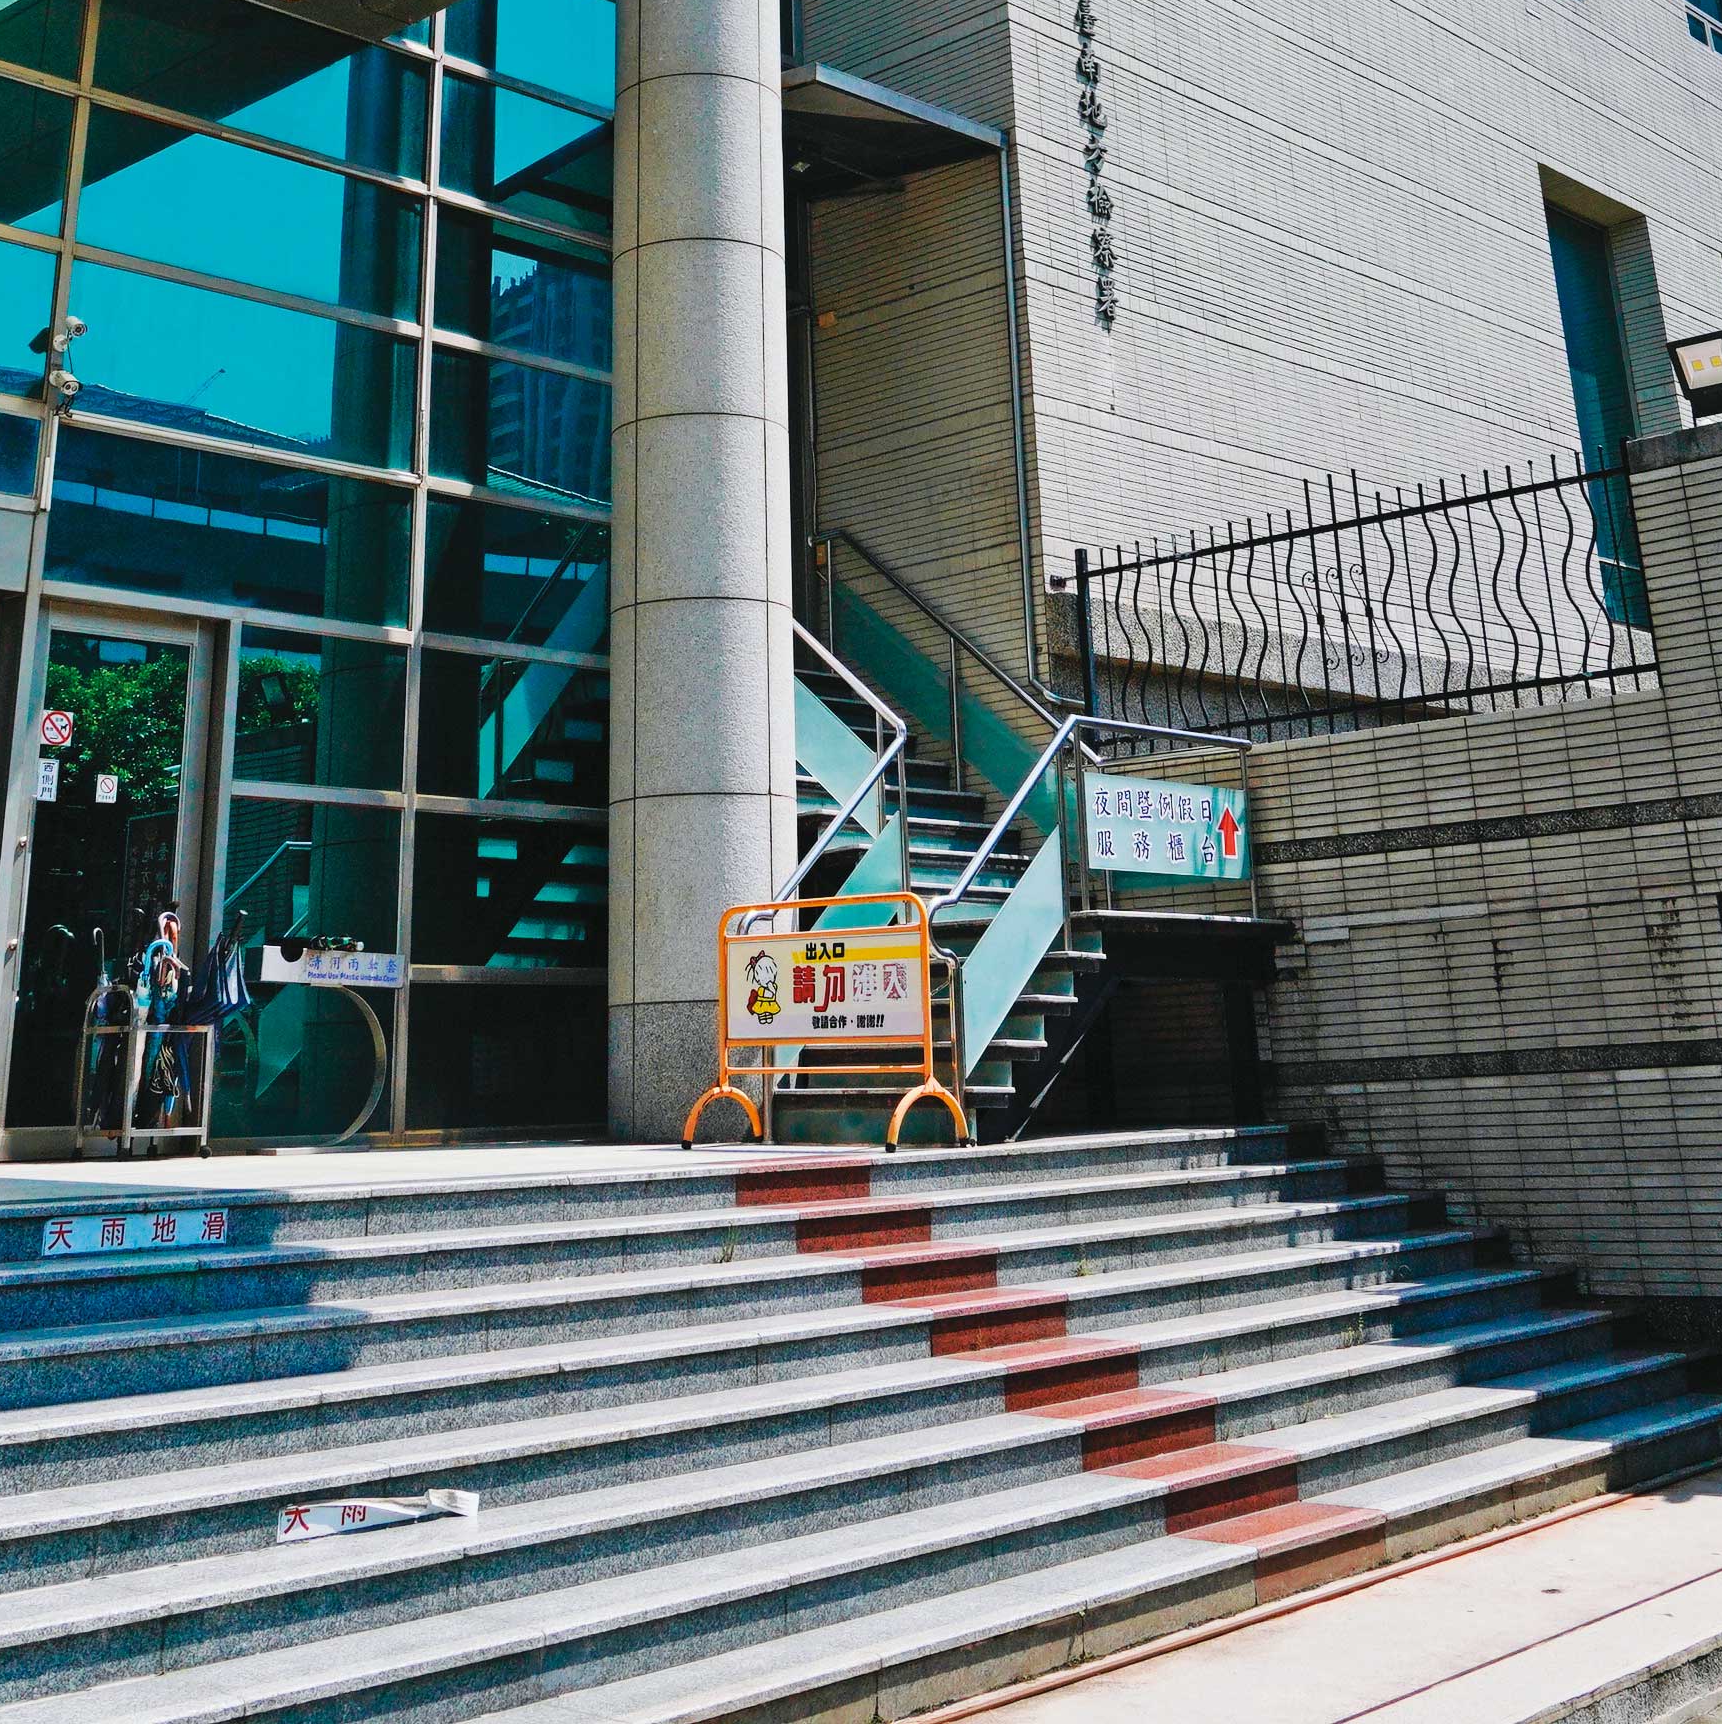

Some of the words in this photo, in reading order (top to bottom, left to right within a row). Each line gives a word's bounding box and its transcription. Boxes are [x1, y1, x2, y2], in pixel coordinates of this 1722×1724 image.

[1094, 787, 1213, 822] 夜間暨例假日
[1096, 829, 1215, 864] 服務櫃台
[805, 942, 845, 961] 出入口
[47, 1212, 226, 1251] 天雨地滑
